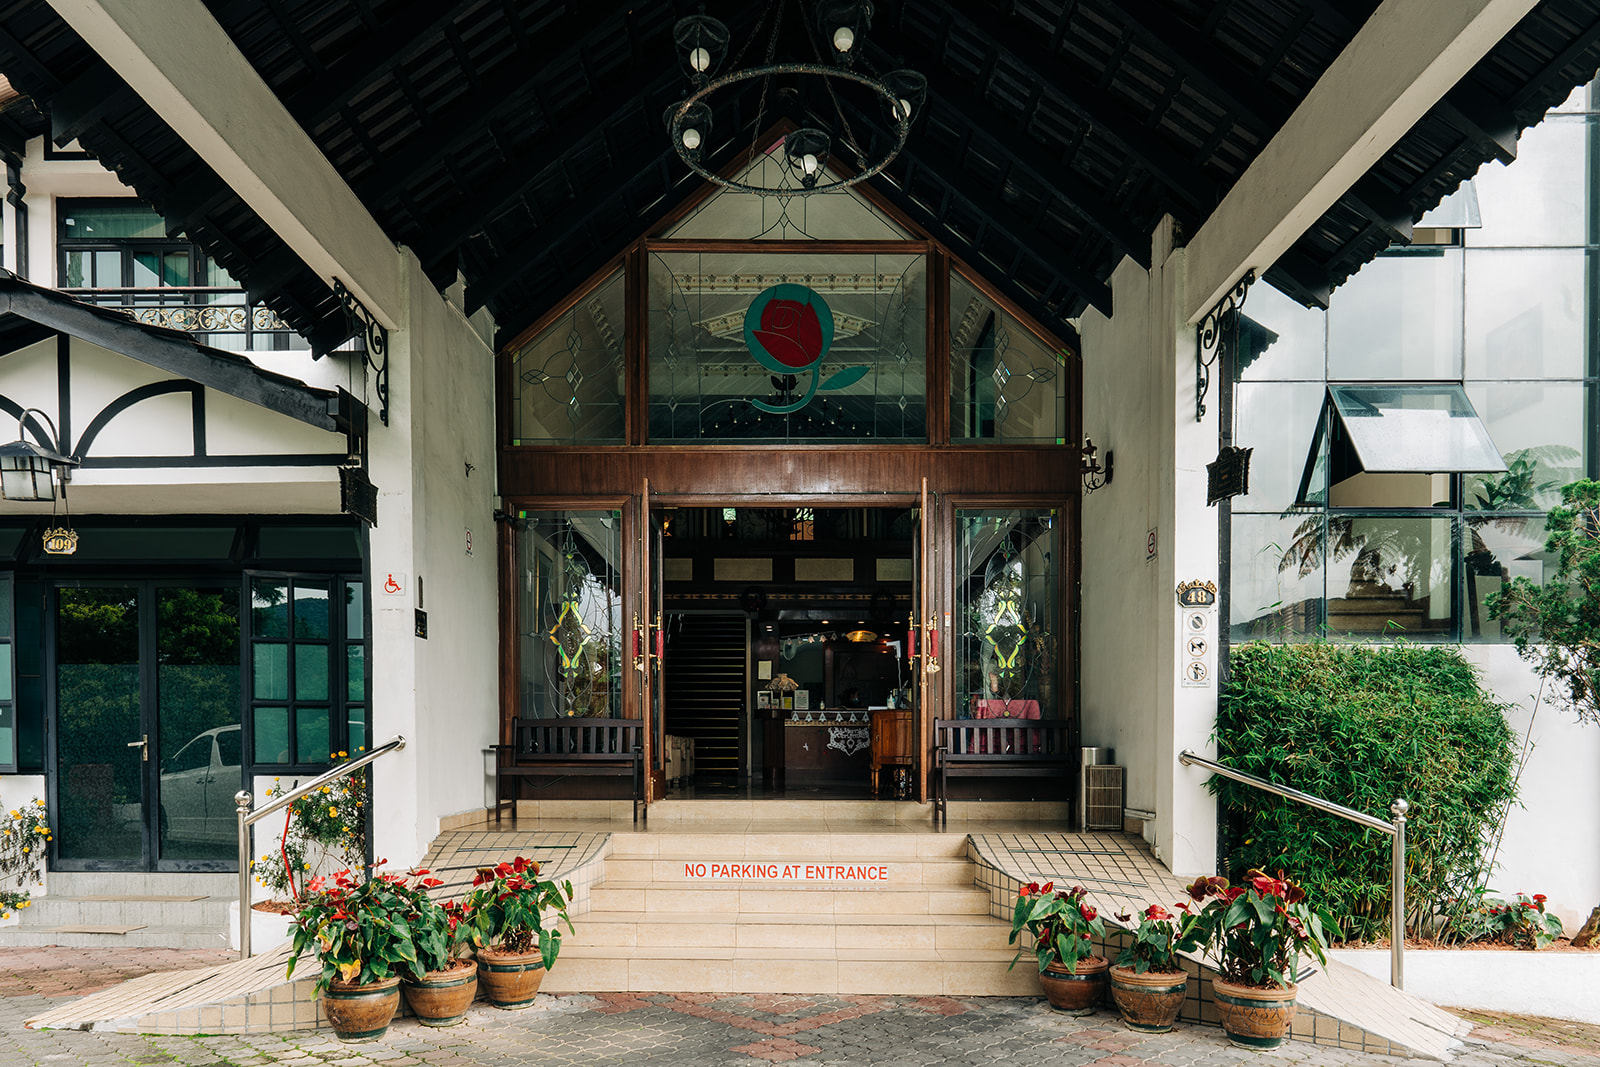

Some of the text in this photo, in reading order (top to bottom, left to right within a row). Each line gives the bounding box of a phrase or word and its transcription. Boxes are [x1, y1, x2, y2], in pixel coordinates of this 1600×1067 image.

[50, 538, 72, 551] 109
[1186, 590, 1207, 603] 48
[685, 863, 888, 880] NO PARKING AT ENTRANCE
